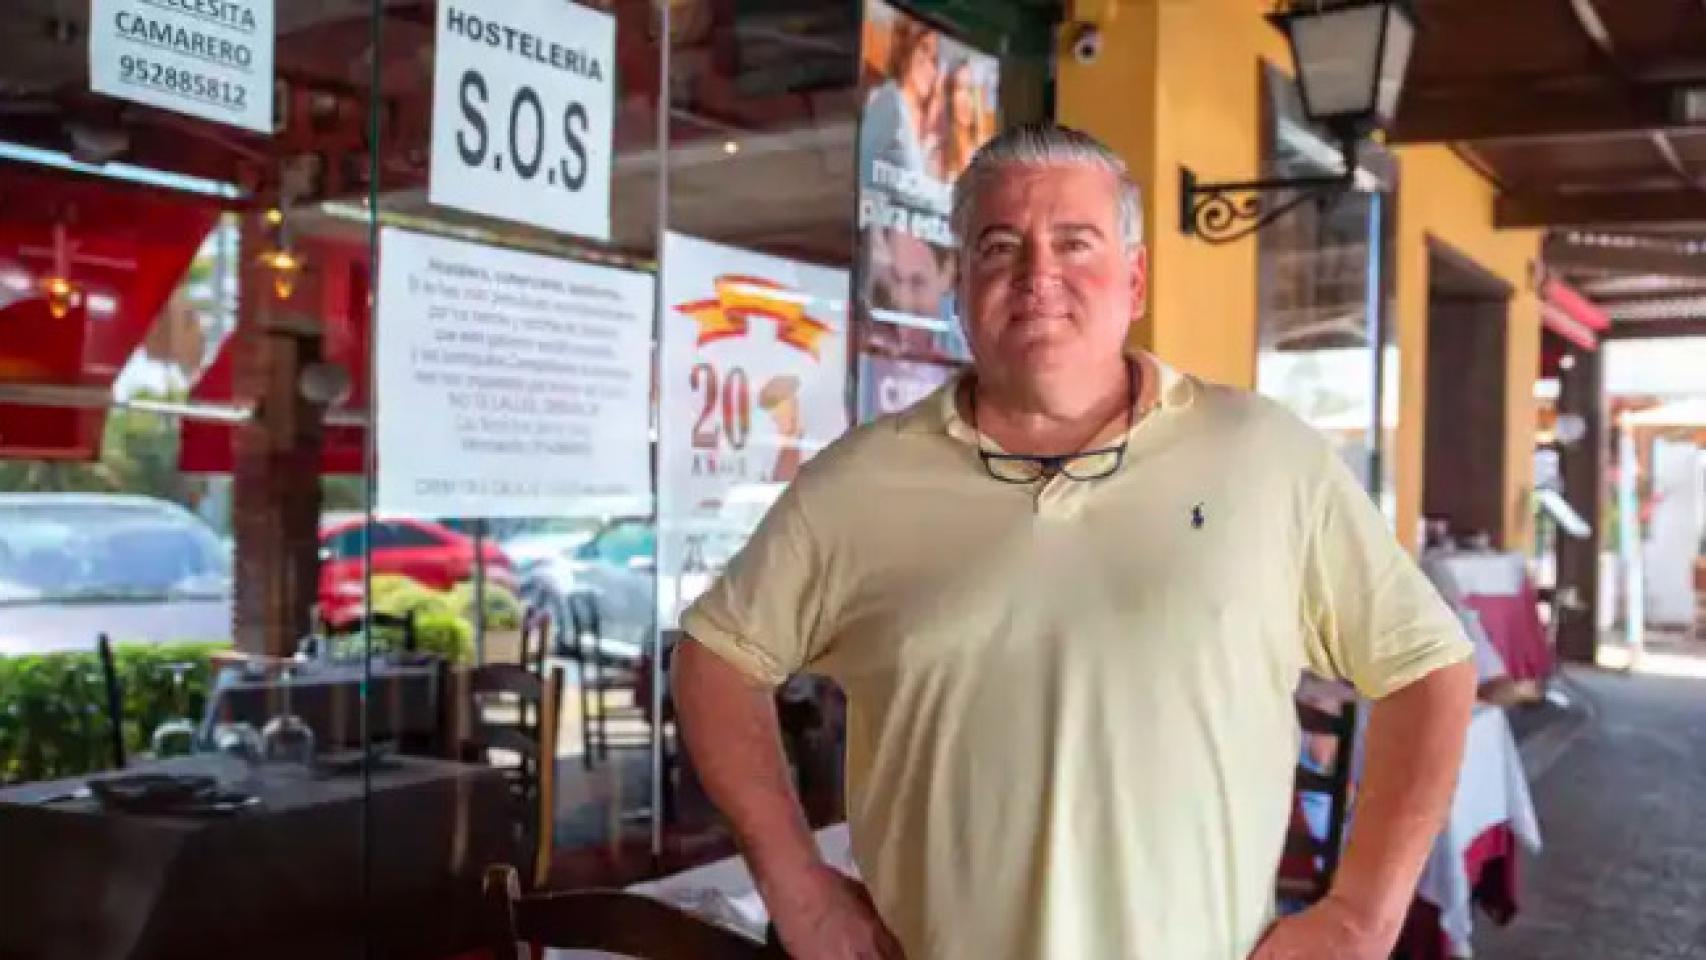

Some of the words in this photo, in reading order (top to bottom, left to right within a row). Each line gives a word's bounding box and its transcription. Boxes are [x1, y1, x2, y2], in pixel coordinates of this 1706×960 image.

[115, 11, 252, 67] CAMARERO
[168, 0, 256, 30] CESITA
[120, 54, 247, 107] 952885812
[455, 69, 590, 192] S.O.S
[689, 363, 751, 449] 20
